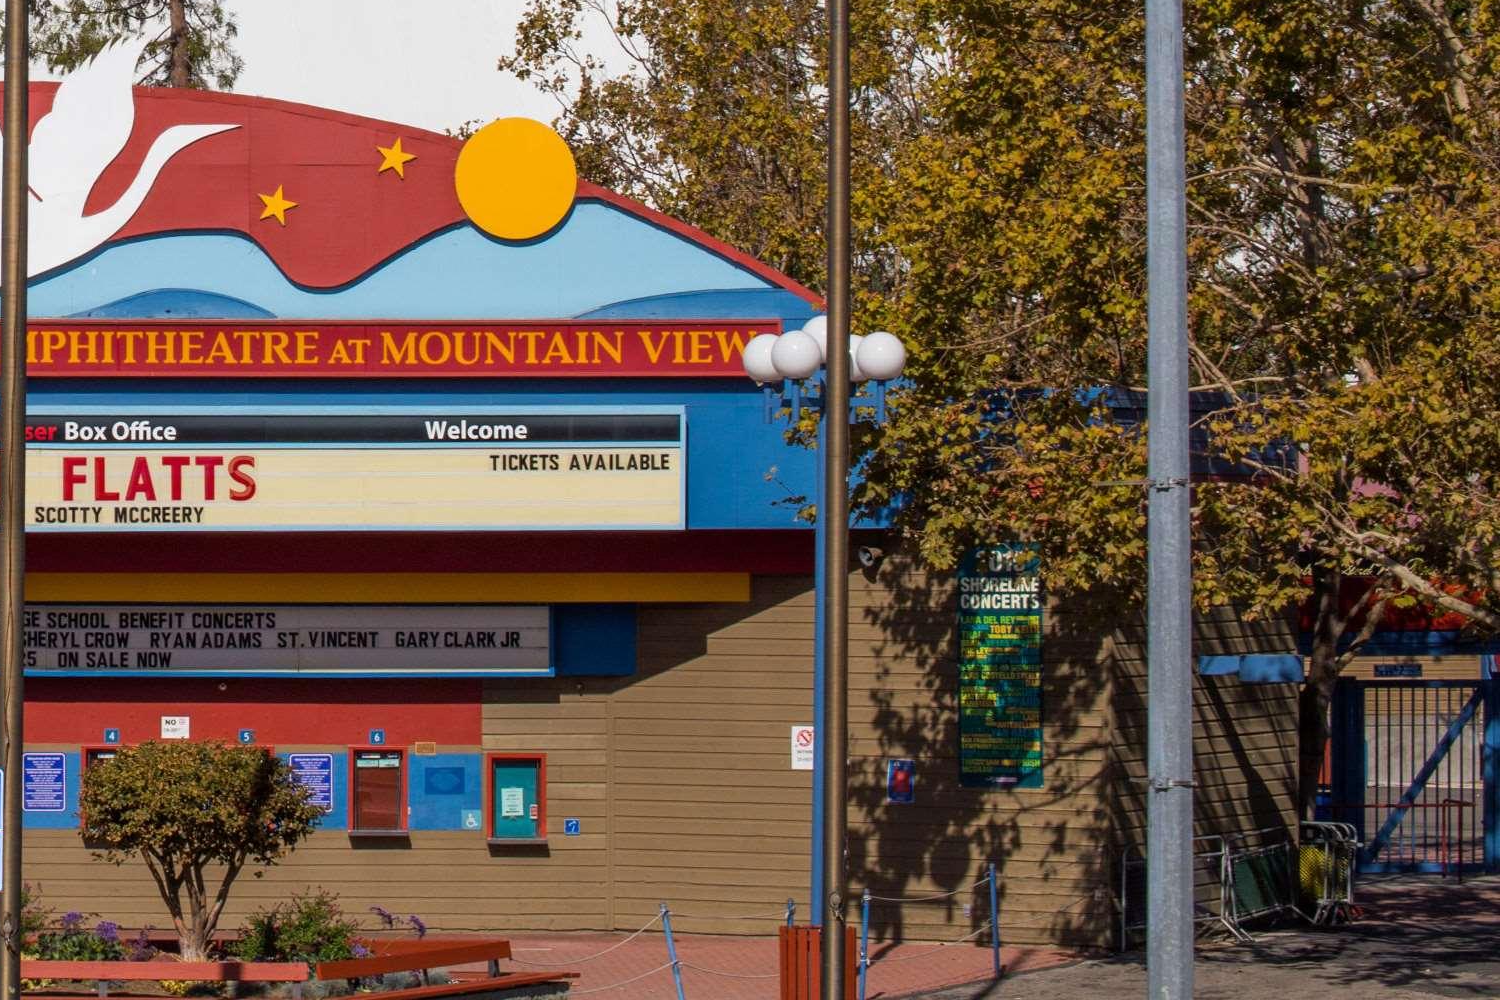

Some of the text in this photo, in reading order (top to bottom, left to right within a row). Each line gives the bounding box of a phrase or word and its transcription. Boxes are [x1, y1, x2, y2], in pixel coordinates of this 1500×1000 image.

[327, 339, 371, 364] AT
[380, 331, 622, 364] MOUNTAIN
[65, 421, 107, 441] Box
[112, 420, 177, 441] Office
[425, 420, 528, 440] Welcome
[489, 454, 670, 471] TICKETS AVAILABLE
[62, 455, 257, 501] FLATTS
[35, 506, 102, 523] SCOTTY
[113, 506, 204, 523] MCCREERY
[960, 594, 1040, 609] CONCERTS
[47, 612, 110, 628] SCHOOL
[119, 612, 185, 629] BENEFIT
[192, 612, 276, 629] CONCERTS
[23, 632, 80, 648] HERYL
[84, 632, 130, 648] CROW
[150, 632, 197, 648] RYAN
[202, 632, 263, 648] ADAMS
[277, 632, 304, 648] ST.
[309, 632, 379, 648] VINCENT
[395, 632, 439, 648] GARY
[443, 632, 496, 648] CLARK
[500, 632, 521, 648] JR
[58, 651, 80, 668] ON
[86, 652, 129, 668] SALE
[137, 652, 172, 668] NOW
